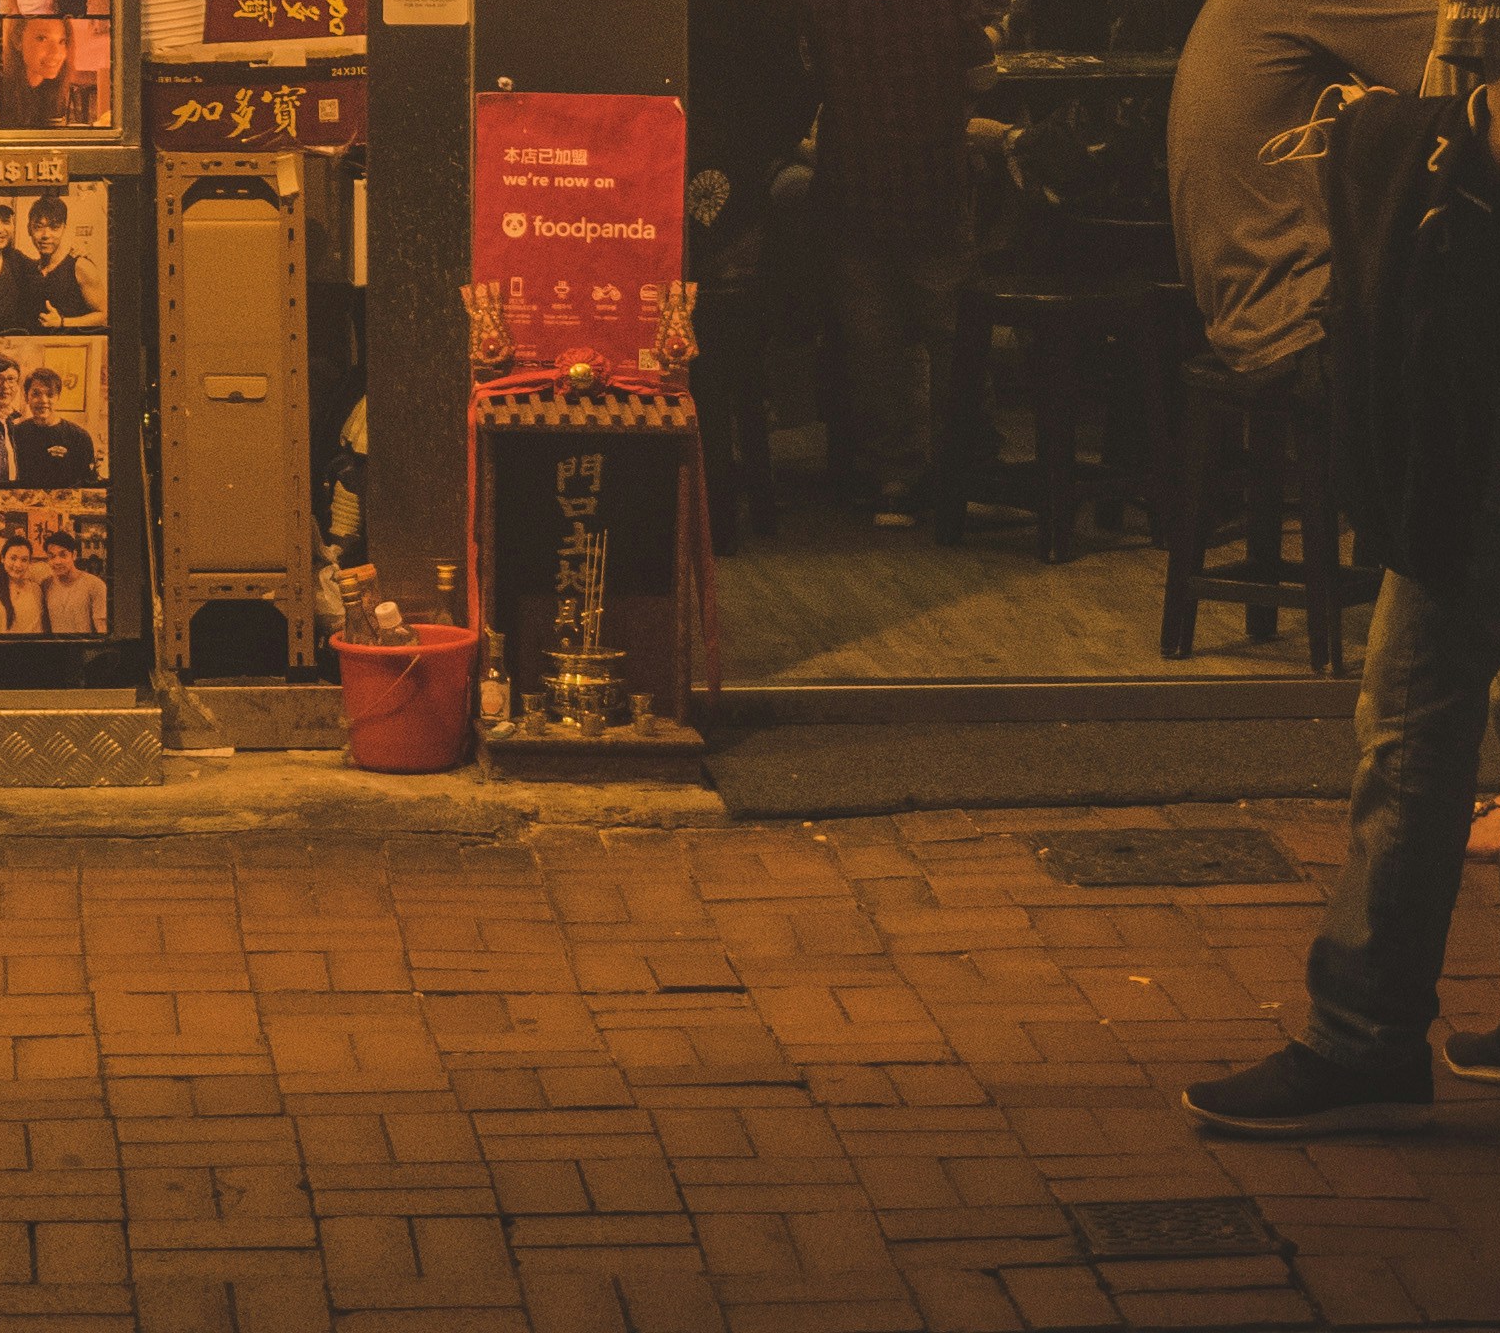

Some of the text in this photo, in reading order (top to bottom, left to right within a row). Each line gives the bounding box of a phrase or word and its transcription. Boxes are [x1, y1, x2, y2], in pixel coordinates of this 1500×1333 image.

[502, 147, 589, 168] 本店已加盟
[502, 173, 615, 189] we're now on
[533, 213, 657, 242] foodpanda
